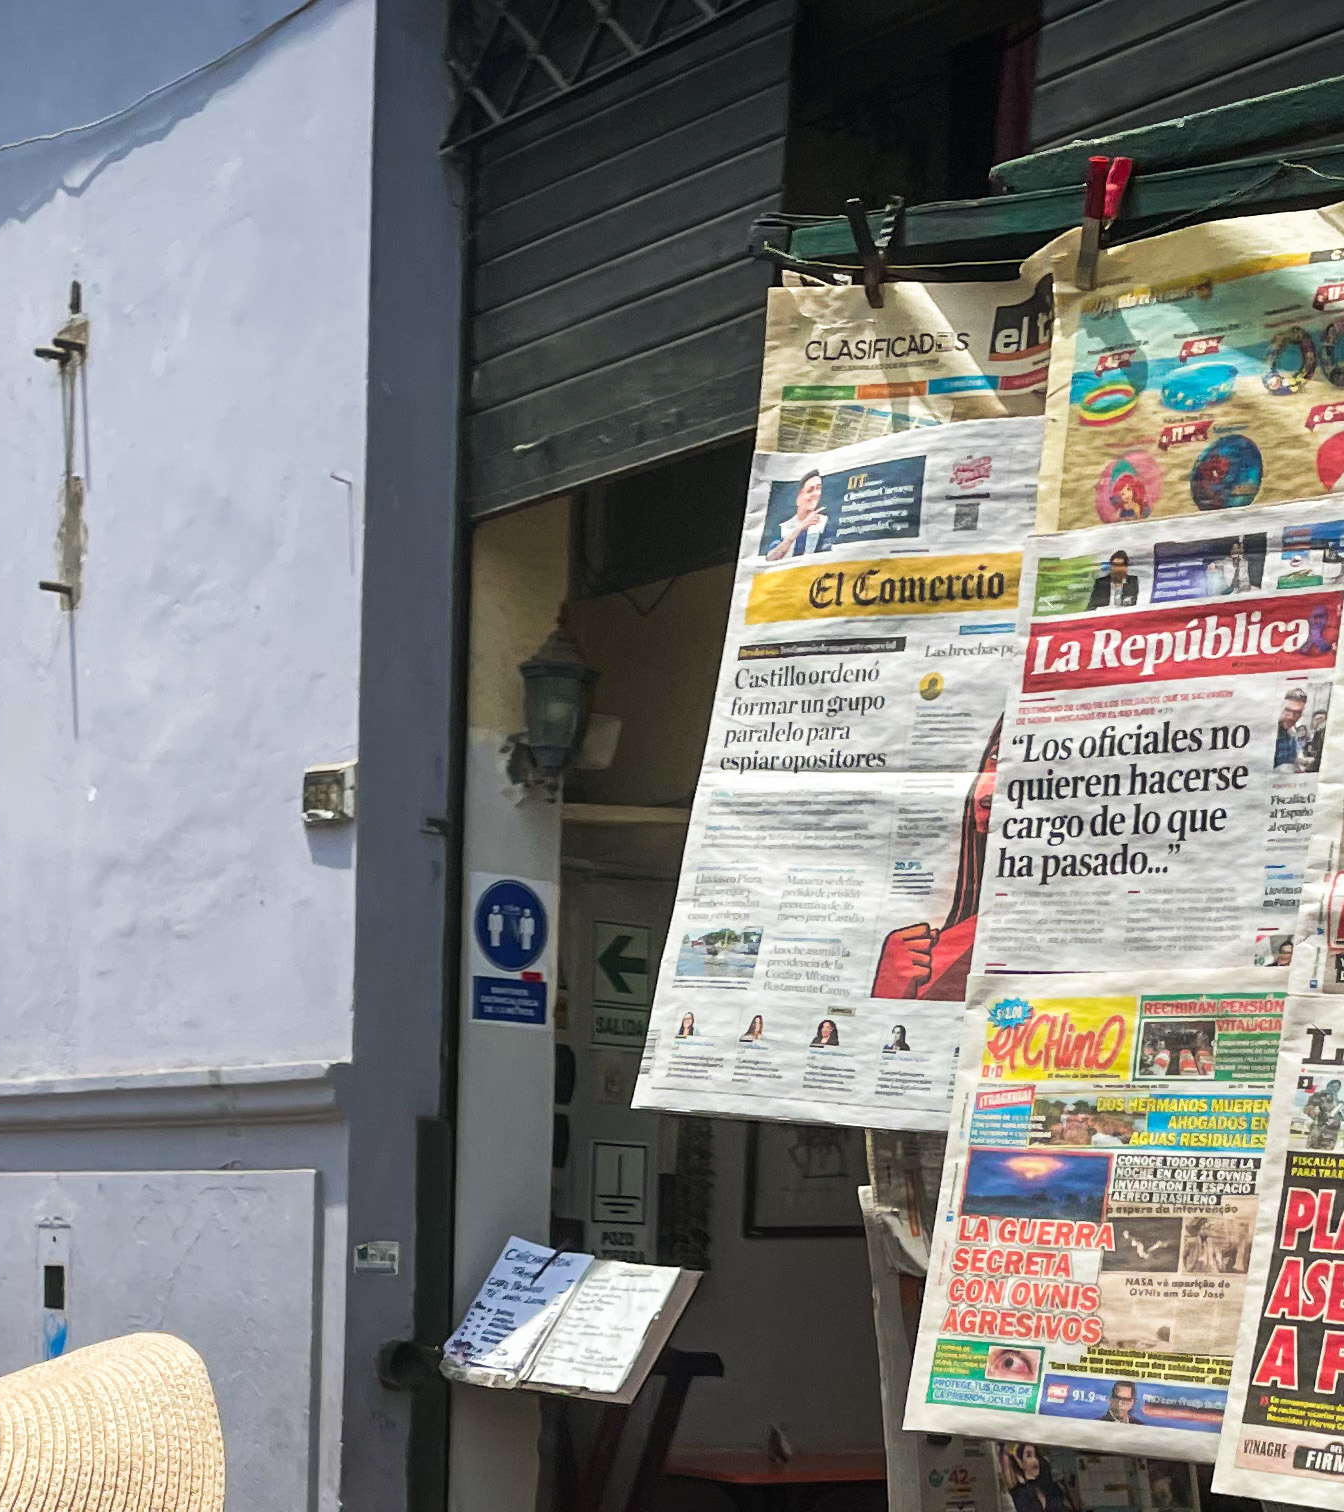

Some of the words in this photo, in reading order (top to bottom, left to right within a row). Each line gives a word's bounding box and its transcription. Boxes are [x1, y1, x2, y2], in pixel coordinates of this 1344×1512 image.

[809, 571, 844, 609] El
[852, 565, 1005, 607] Comercio
[1031, 634, 1080, 676] La
[1087, 610, 1309, 677] República
[734, 665, 806, 690] Castillo
[808, 660, 880, 682] ordenó
[730, 696, 799, 717] formar
[801, 697, 824, 713] un
[826, 692, 886, 718] grupo
[724, 720, 805, 748] paralelo
[806, 724, 851, 746] para
[1078, 721, 1203, 759] oficiales
[1208, 724, 1252, 751] no
[720, 752, 780, 775] espiar
[781, 748, 888, 773] opositores
[1007, 769, 1122, 809] quieren
[1126, 763, 1249, 796] hacerse
[1002, 812, 1084, 847] cargo
[1090, 805, 1127, 838] de
[1130, 802, 1161, 836] lo
[1167, 805, 1227, 842] que
[995, 847, 1034, 879] ha
[958, 1216, 990, 1245] LA
[998, 1218, 1115, 1251] GUERRA
[952, 1249, 1072, 1279] SECRETA
[948, 1277, 1005, 1306] CON
[1010, 1278, 1099, 1312] OVNIS
[942, 1308, 1102, 1344] AGRESIVOS
[1252, 1324, 1299, 1391] A
[1243, 1439, 1287, 1460] VINAGRE
